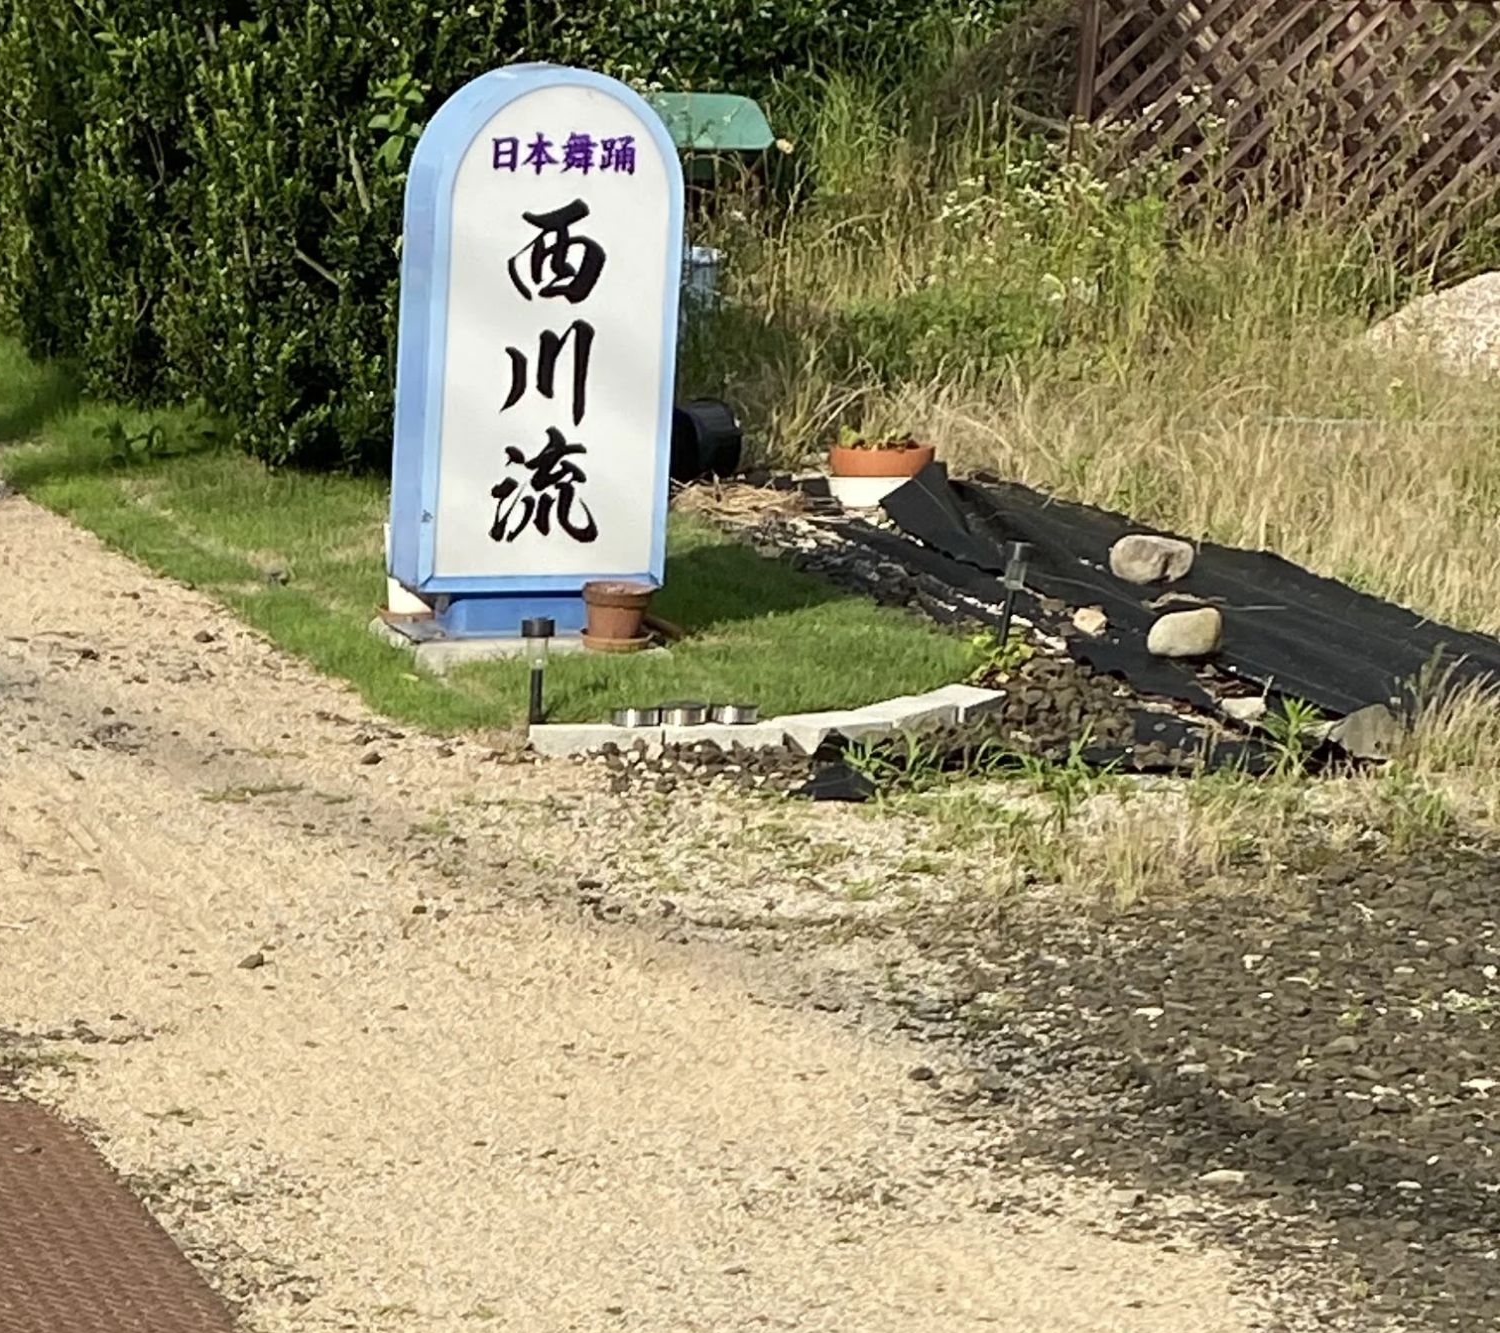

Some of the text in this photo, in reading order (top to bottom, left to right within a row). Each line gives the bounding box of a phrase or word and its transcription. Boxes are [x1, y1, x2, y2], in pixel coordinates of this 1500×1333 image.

[491, 132, 636, 175] 日本舞踊
[489, 199, 605, 543] 西川流
